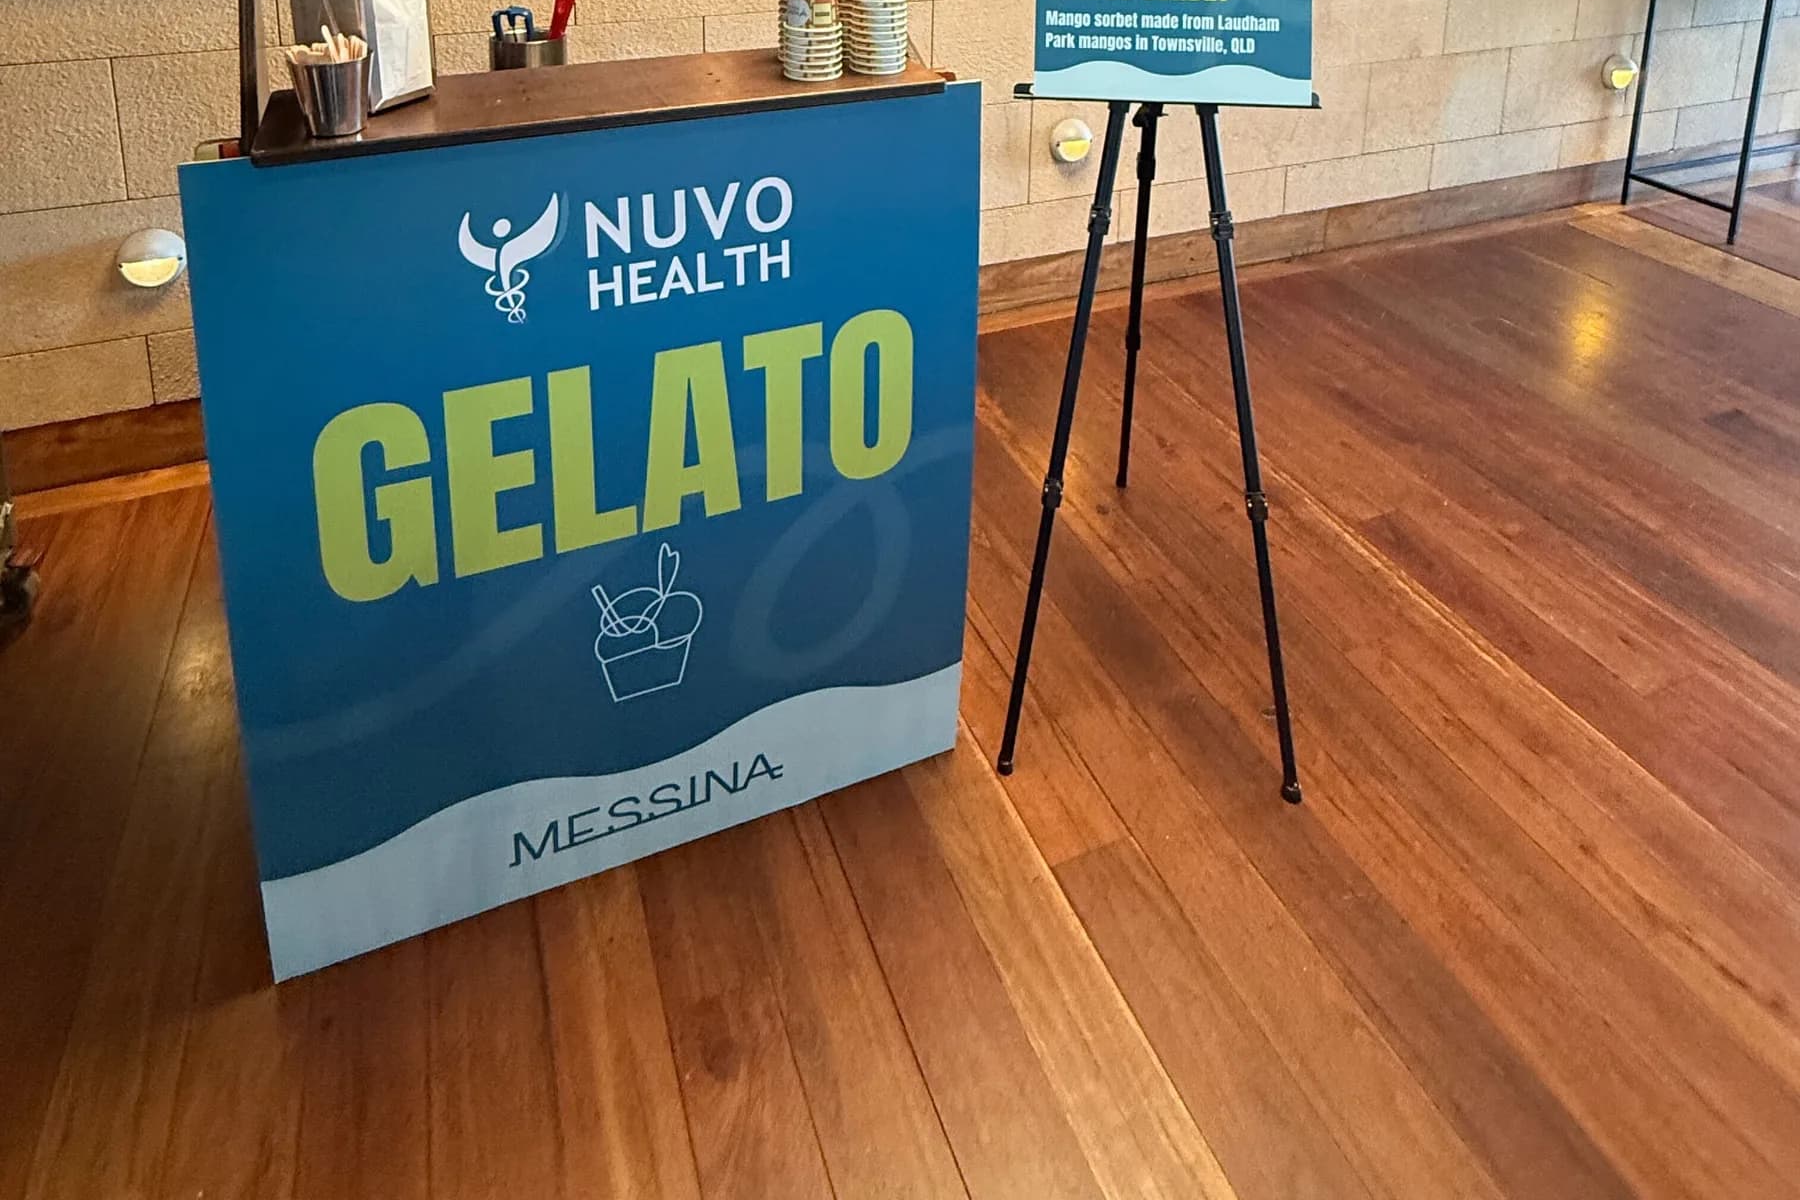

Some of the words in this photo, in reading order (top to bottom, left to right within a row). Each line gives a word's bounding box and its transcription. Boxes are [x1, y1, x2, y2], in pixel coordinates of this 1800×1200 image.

[1045, 9, 1091, 28] Mango
[1093, 11, 1138, 28] sorbet
[1140, 13, 1179, 29] made
[1182, 13, 1215, 30] from
[1217, 14, 1280, 32] Laudham
[1045, 32, 1076, 49] Park
[1078, 34, 1132, 52] mangos
[1135, 34, 1149, 51] in
[1151, 34, 1228, 55] Townsville,
[1230, 37, 1256, 55] QLD
[585, 176, 793, 259] NUVO
[588, 238, 791, 311] HEALTH
[312, 310, 914, 602] GELATO
[509, 753, 783, 868] MESSINA
